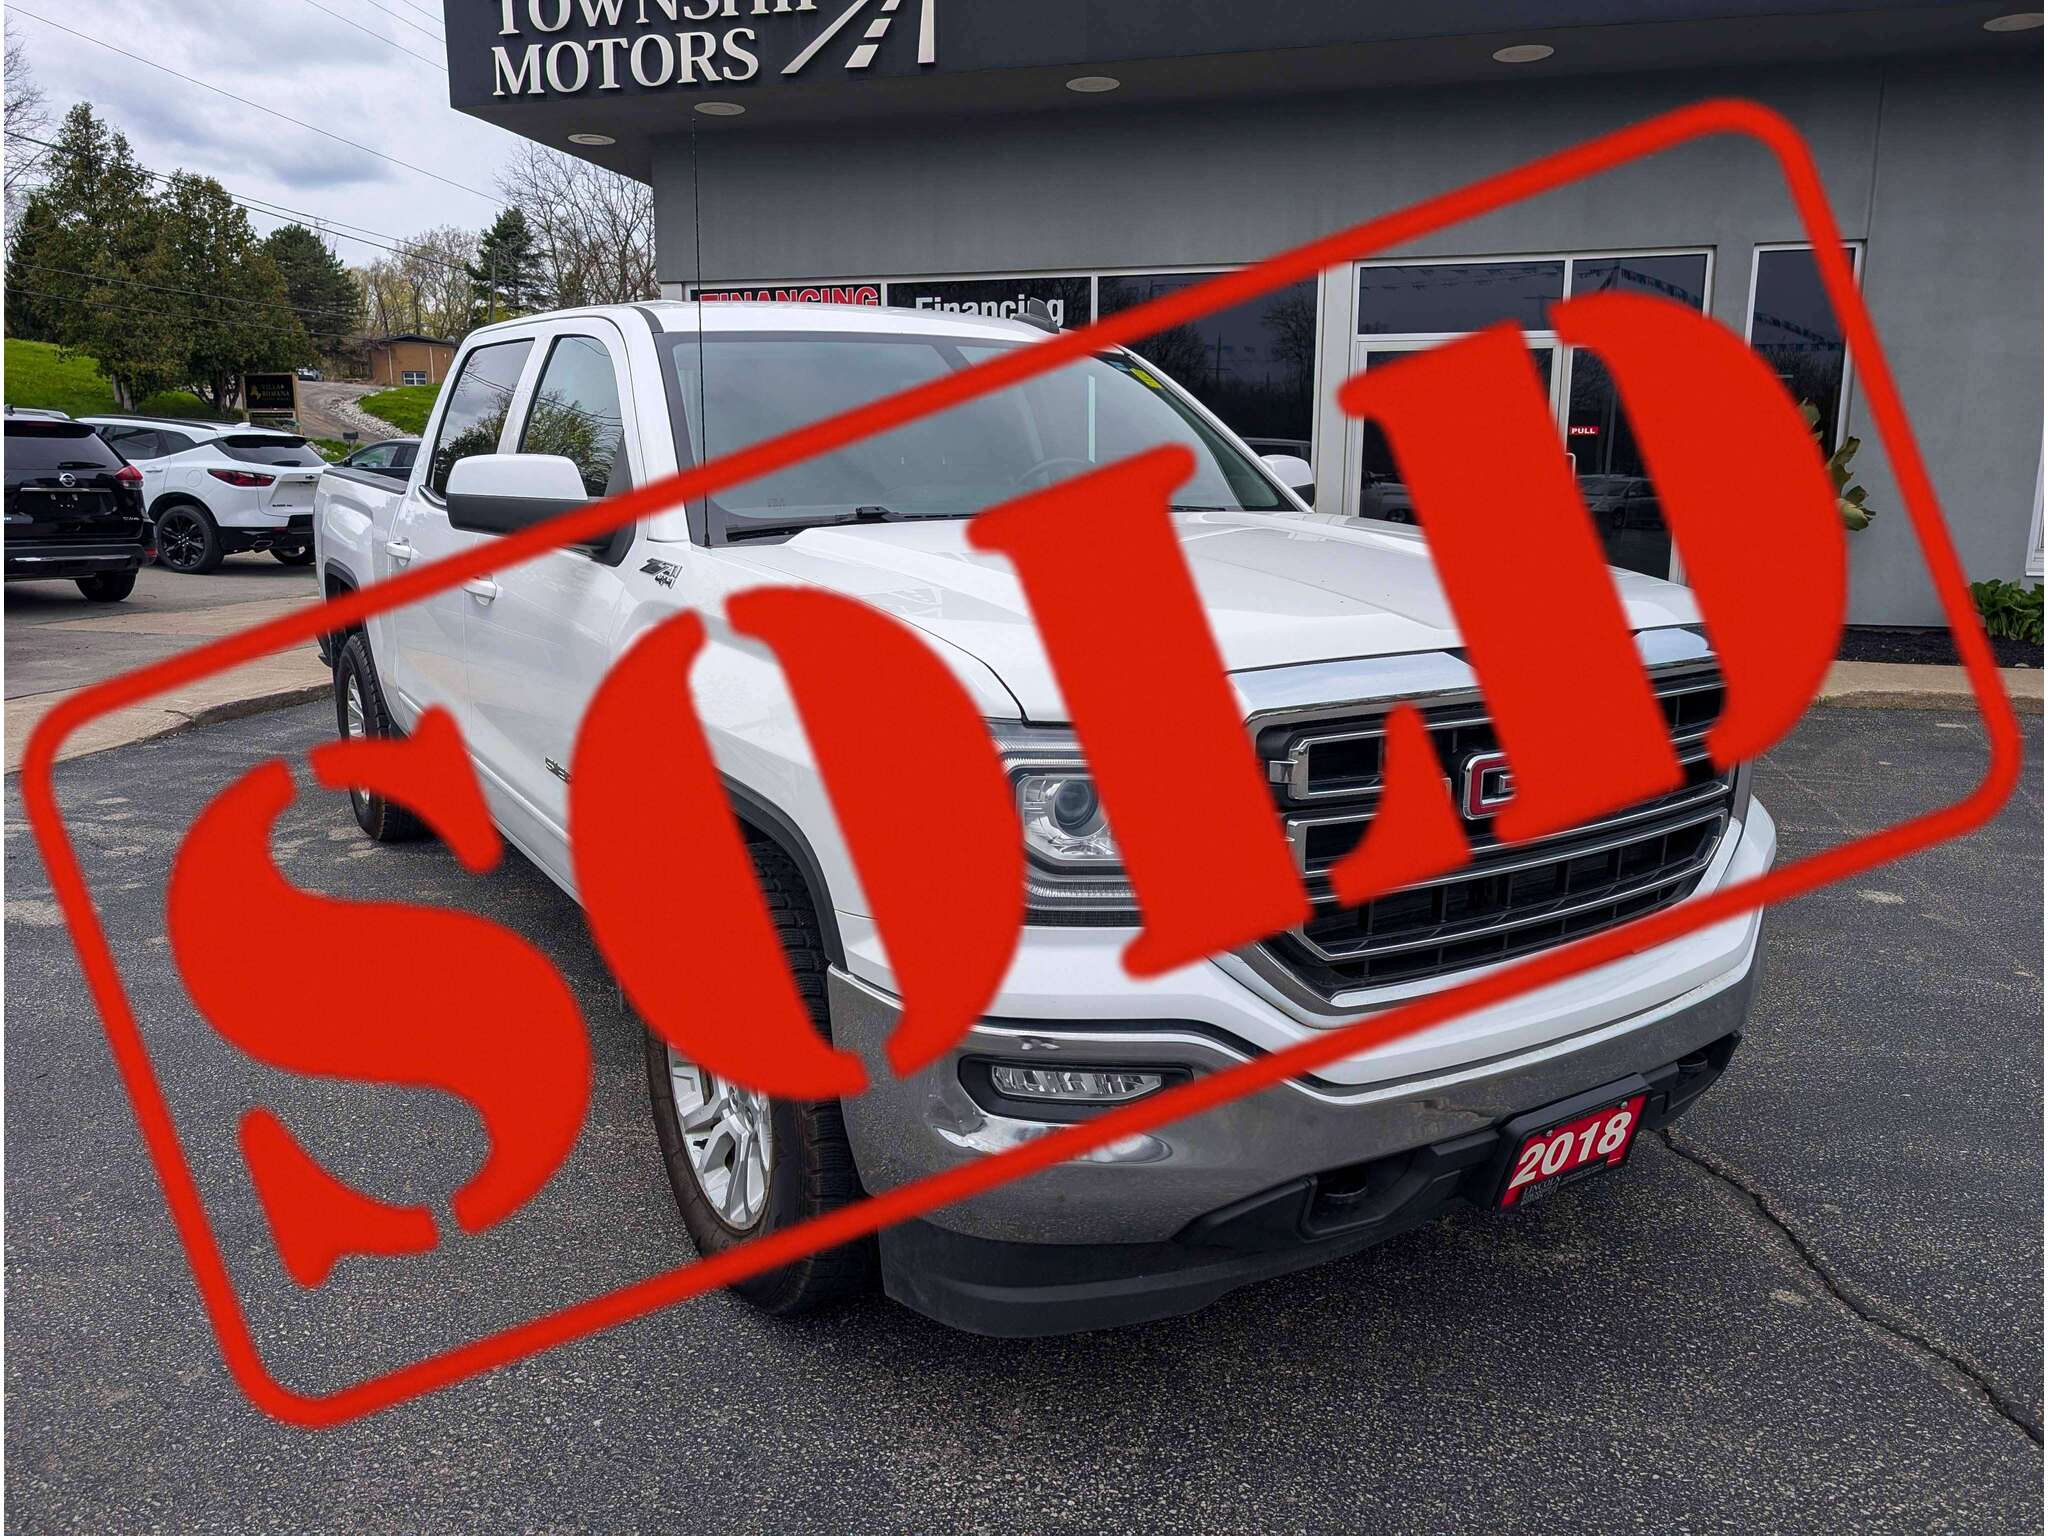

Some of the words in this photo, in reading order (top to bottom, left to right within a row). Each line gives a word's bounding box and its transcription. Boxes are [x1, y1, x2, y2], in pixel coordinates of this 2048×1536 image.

[491, 27, 759, 96] MOTORS
[915, 293, 1064, 328] Financig
[1571, 427, 1596, 435] PULL
[1508, 1111, 1632, 1190] 2018
